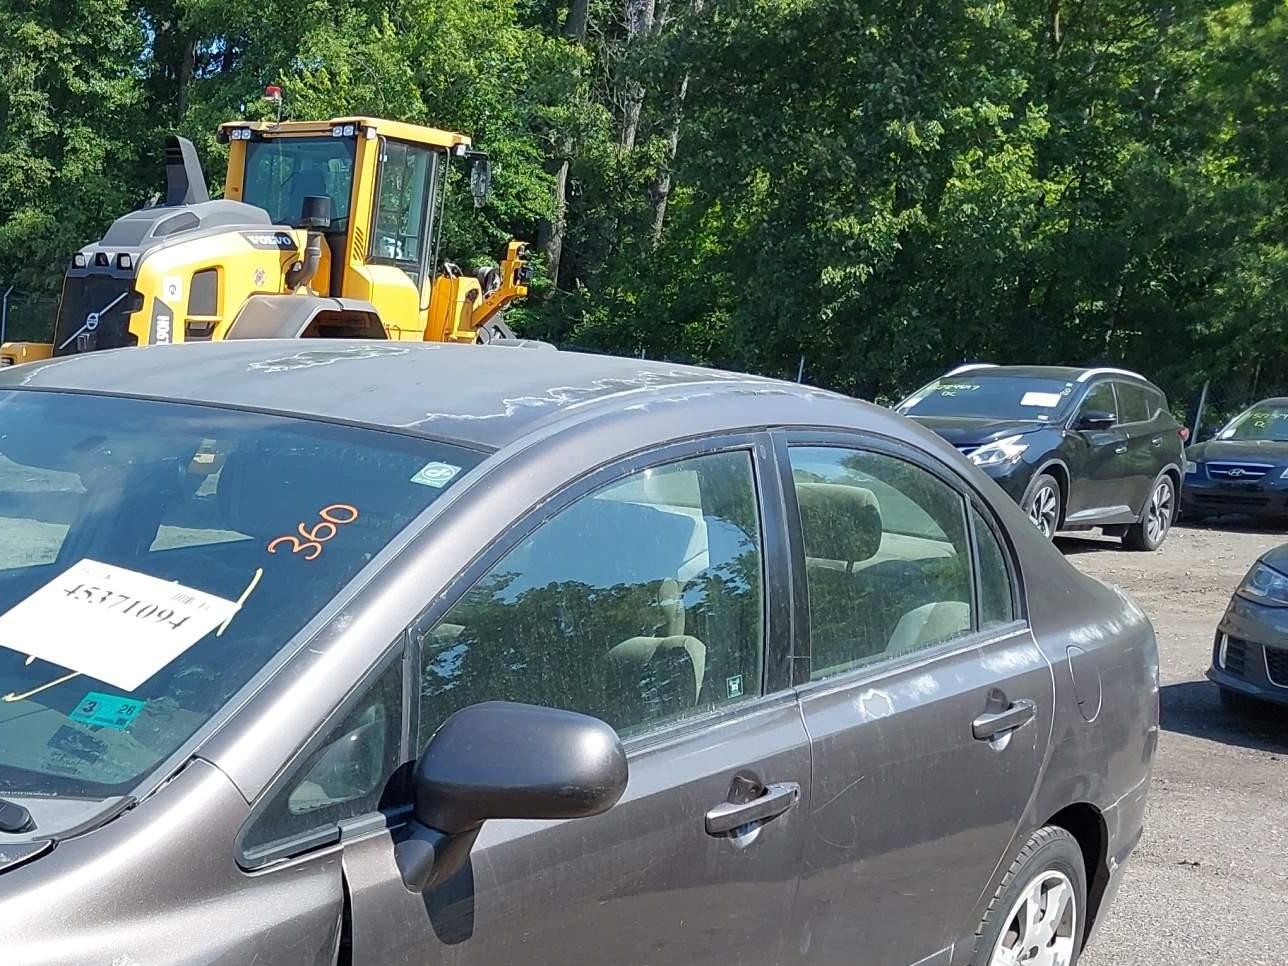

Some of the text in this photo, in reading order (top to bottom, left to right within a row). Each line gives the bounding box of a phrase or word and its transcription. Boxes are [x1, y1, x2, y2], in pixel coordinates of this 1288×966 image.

[247, 235, 292, 245] VOLVO
[267, 503, 359, 560] 360
[63, 583, 192, 630] 45371094
[82, 701, 98, 713] 3
